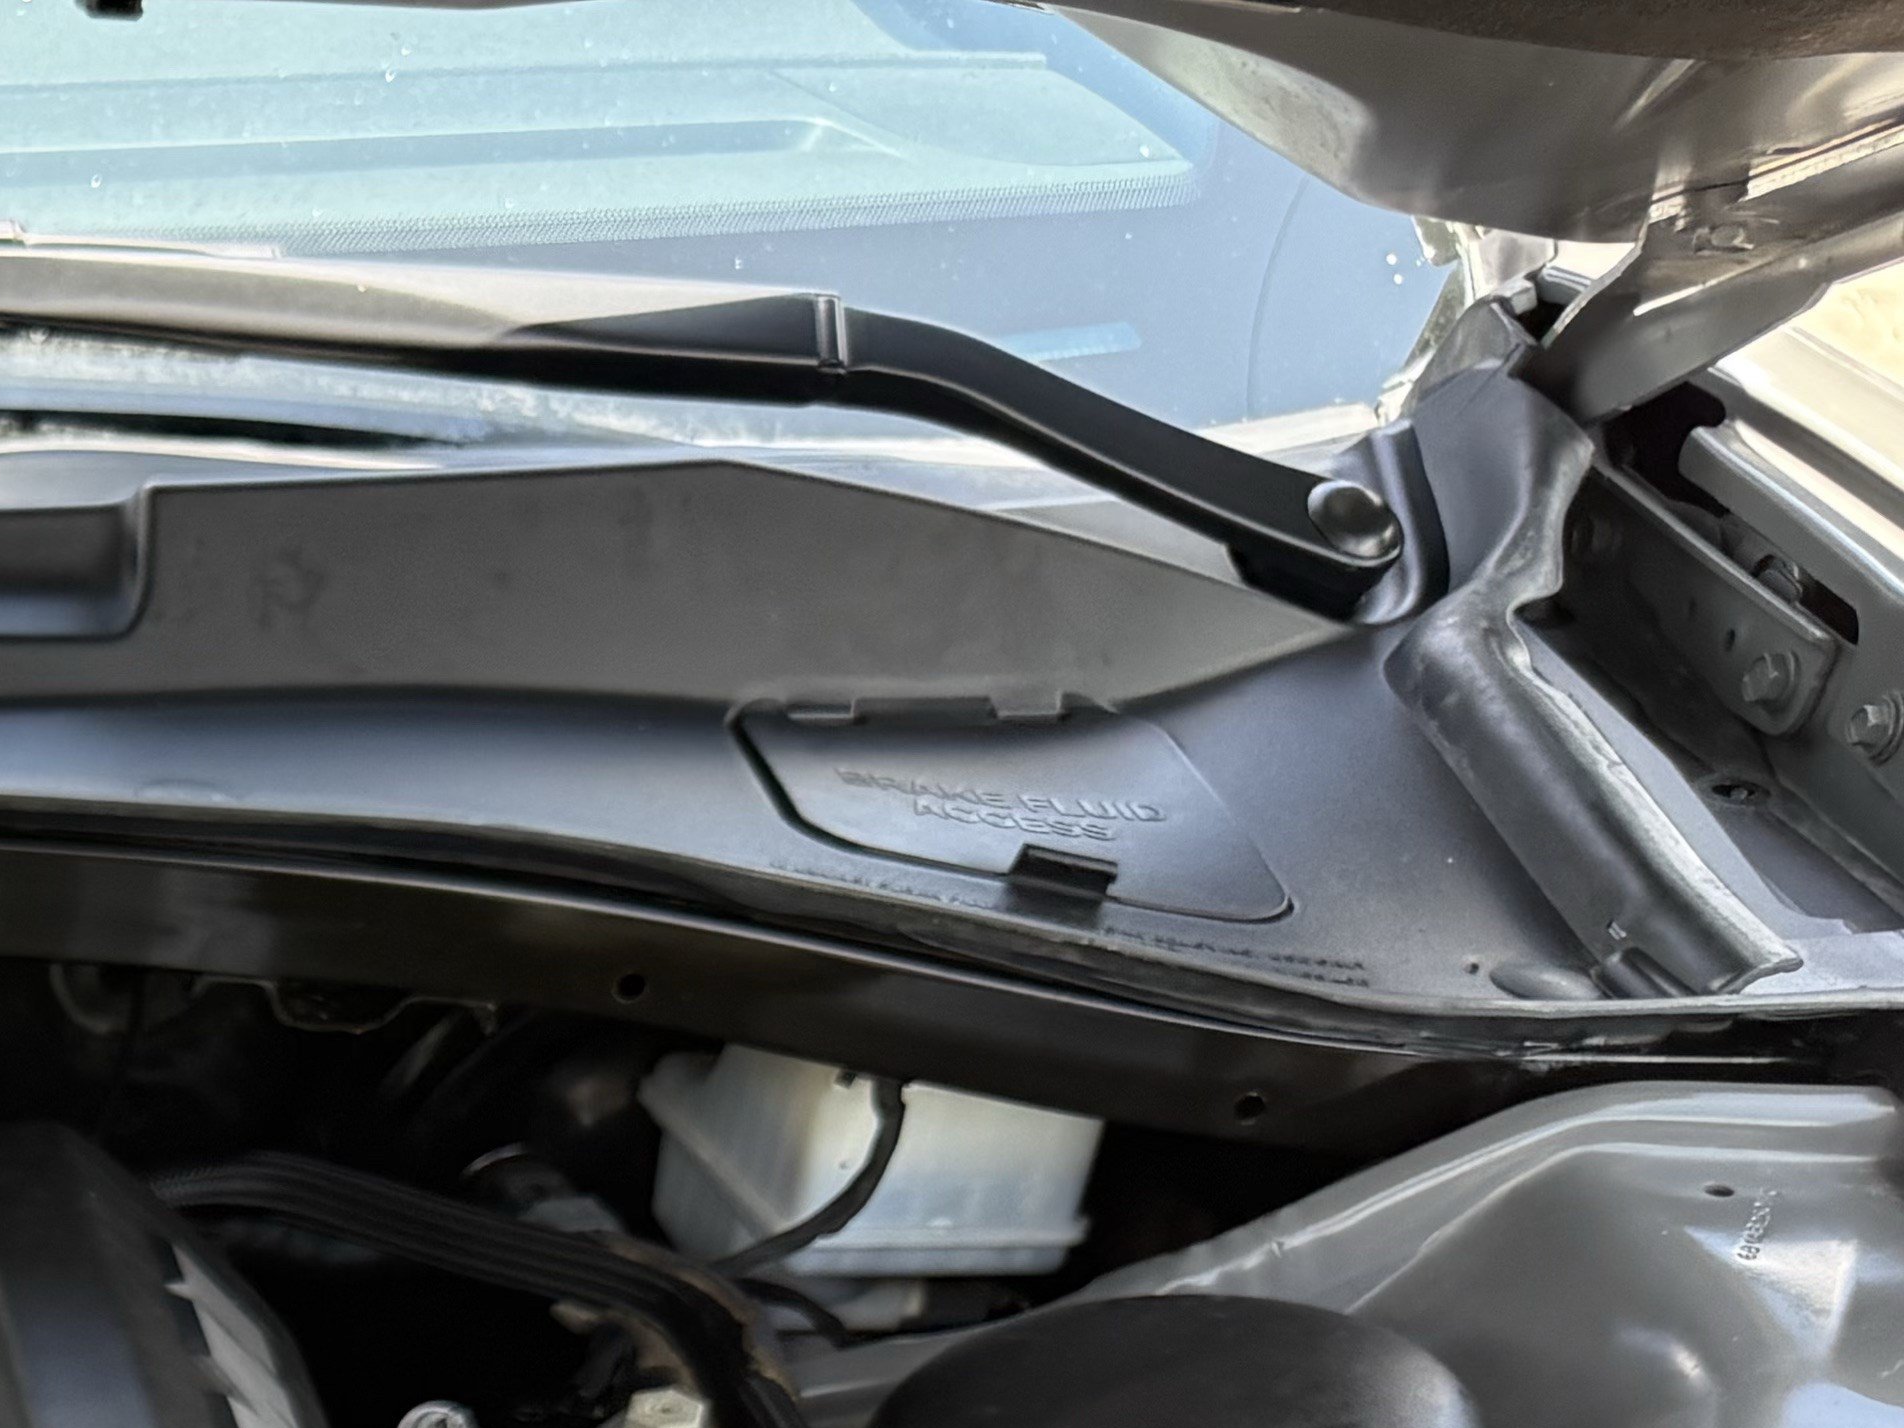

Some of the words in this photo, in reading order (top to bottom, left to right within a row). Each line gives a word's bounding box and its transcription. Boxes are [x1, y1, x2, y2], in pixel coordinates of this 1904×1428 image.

[834, 767, 1004, 803] BRAKE
[1018, 794, 1167, 824] FLUID
[913, 798, 1118, 841] ACCESS
